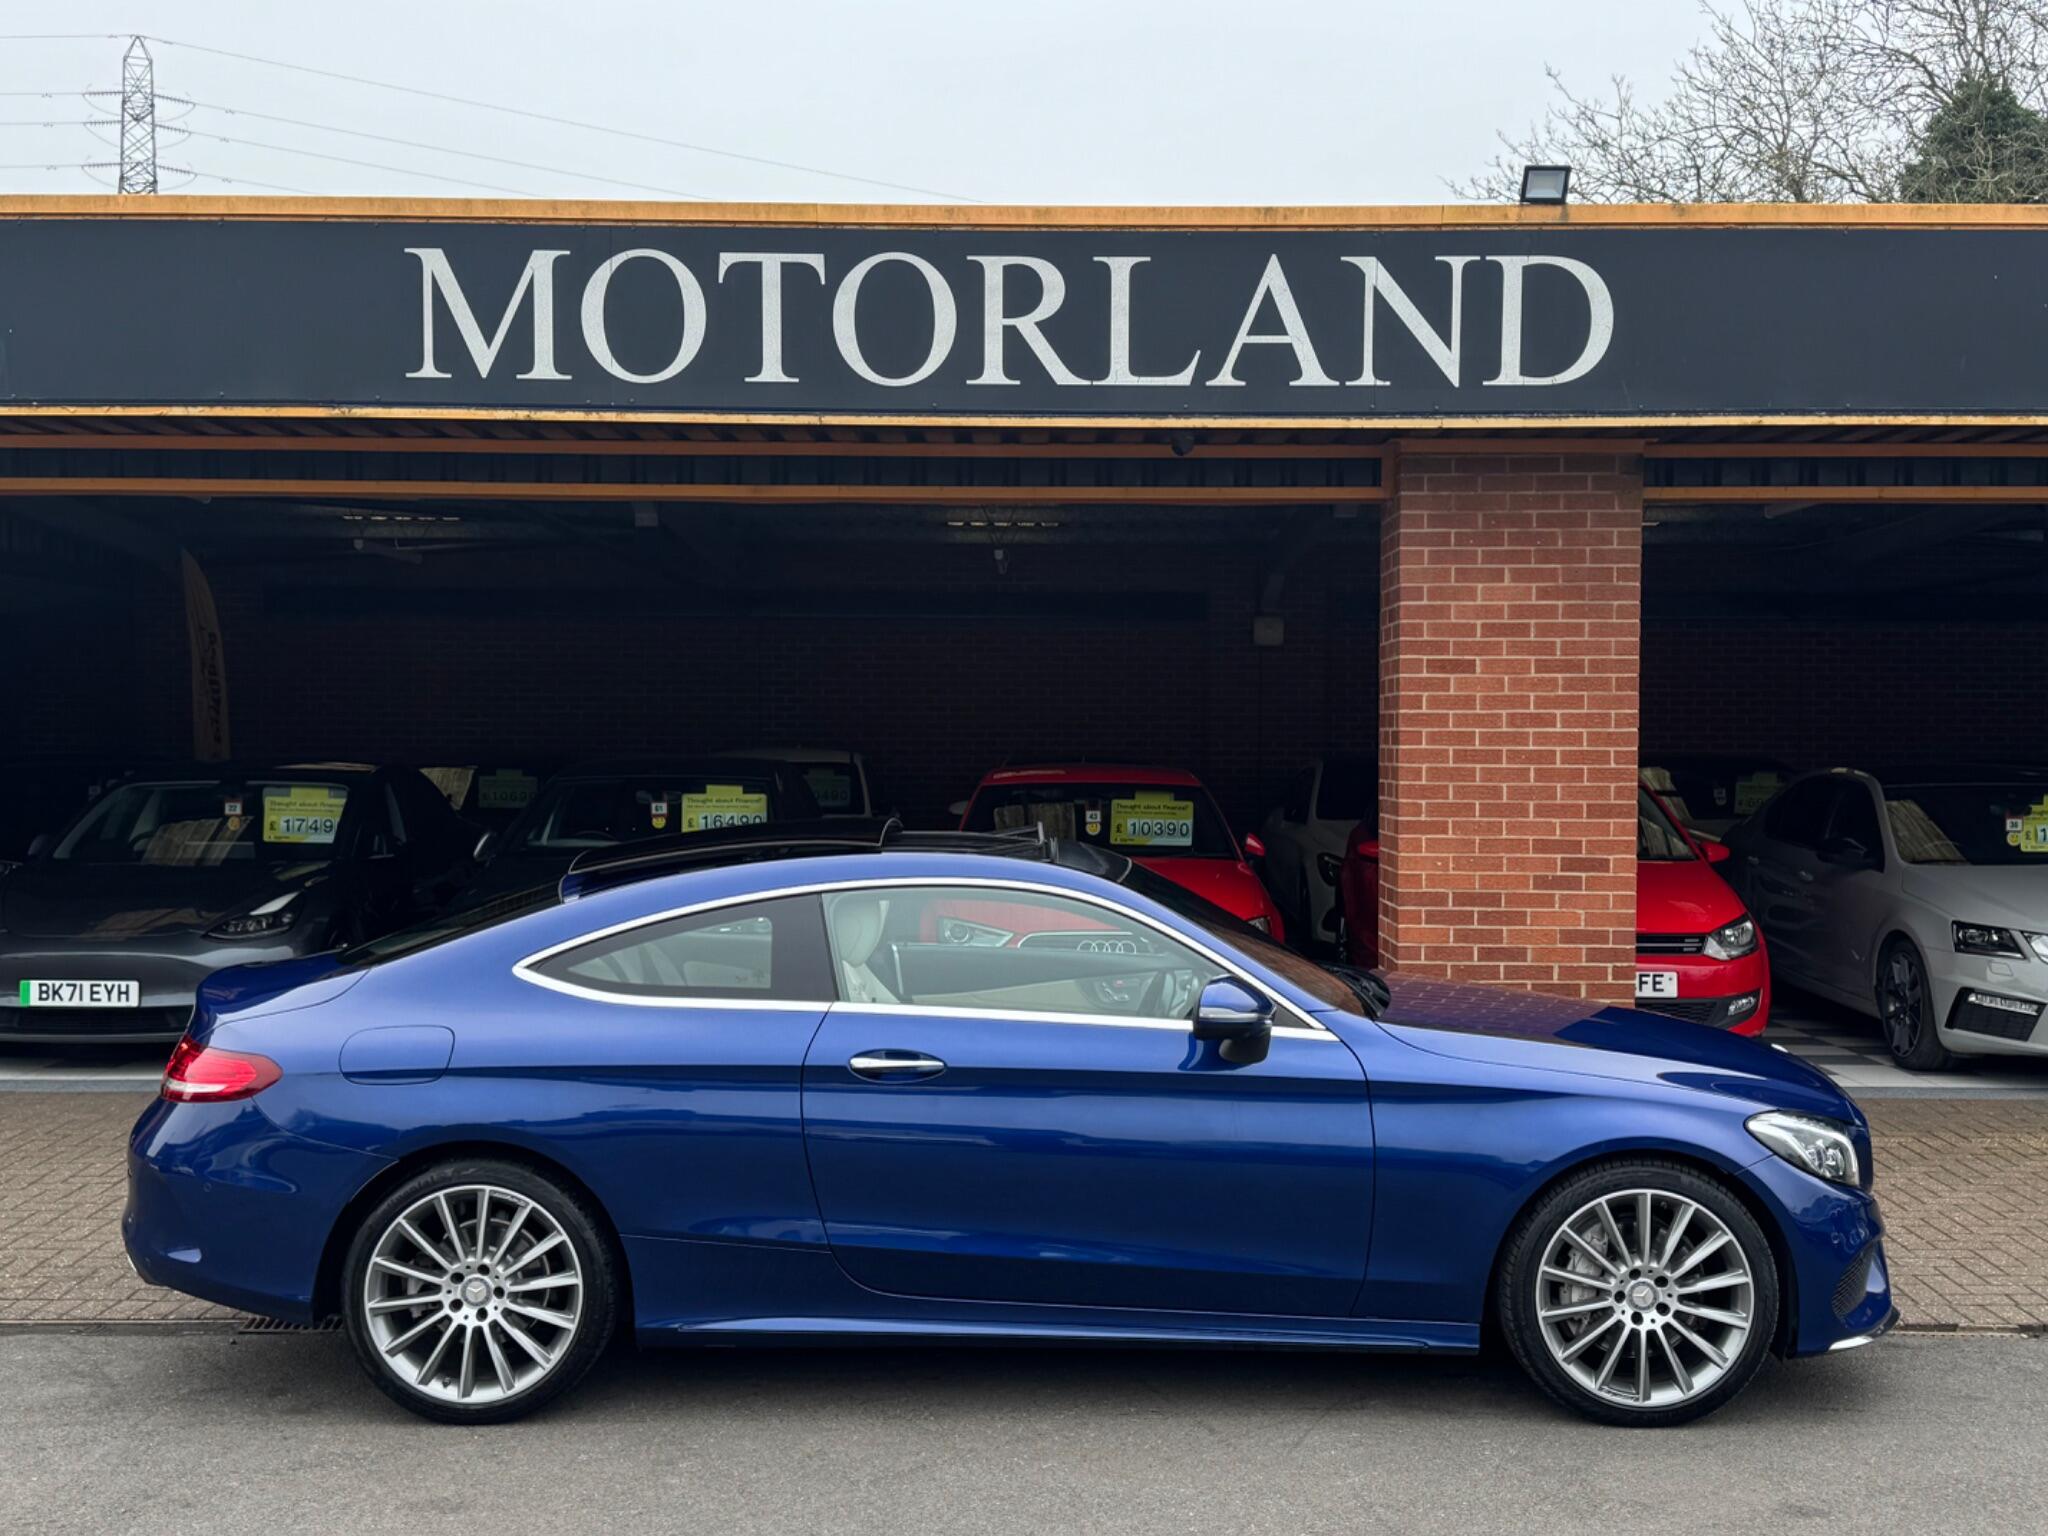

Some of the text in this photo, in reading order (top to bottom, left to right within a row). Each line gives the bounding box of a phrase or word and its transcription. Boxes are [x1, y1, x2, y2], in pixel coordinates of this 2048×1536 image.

[404, 246, 1615, 388] MOTORLAND
[283, 818, 334, 834] 1749
[701, 814, 762, 829] 16490
[1130, 821, 1190, 837] 10390
[1638, 973, 1665, 992] FE
[37, 982, 130, 1003] BK71 EYH
